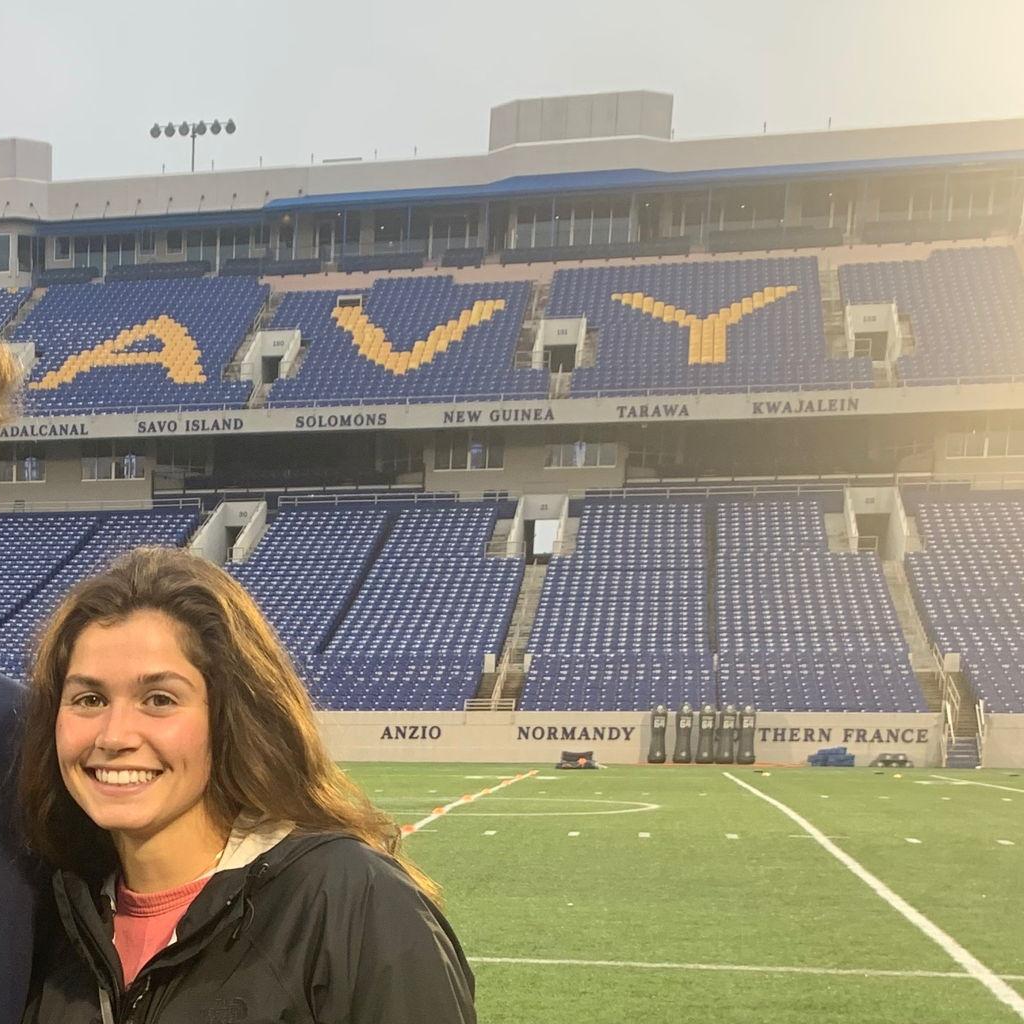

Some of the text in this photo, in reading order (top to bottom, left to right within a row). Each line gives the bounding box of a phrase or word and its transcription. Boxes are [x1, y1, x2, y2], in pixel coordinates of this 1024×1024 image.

[617, 403, 689, 418] TARAWA
[752, 398, 860, 415] KWAJALEIN
[295, 413, 387, 428] SOLOMONS
[443, 408, 554, 424] NEW GUINEA
[138, 418, 244, 433] SAVO ISLAND
[381, 725, 442, 740] ANZIO
[517, 726, 635, 741] NORMANDY
[758, 727, 929, 744] THERN FRANCE
